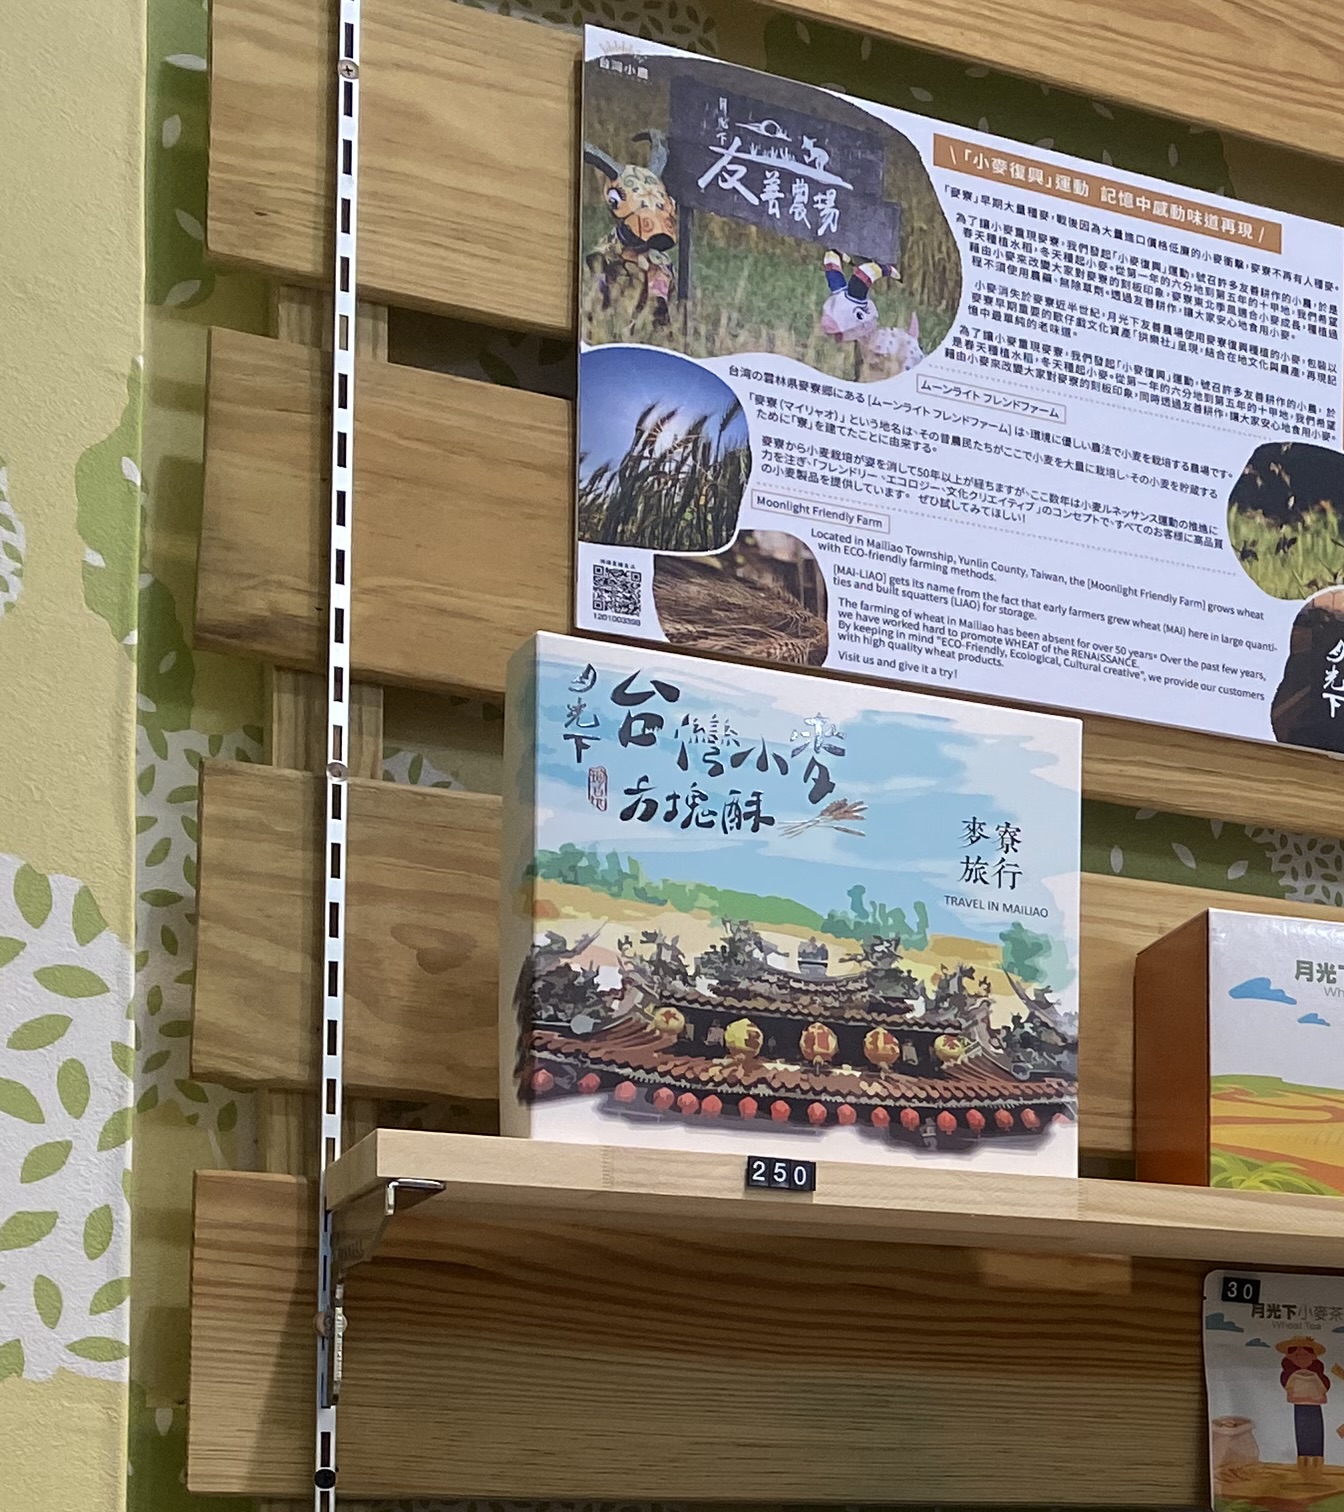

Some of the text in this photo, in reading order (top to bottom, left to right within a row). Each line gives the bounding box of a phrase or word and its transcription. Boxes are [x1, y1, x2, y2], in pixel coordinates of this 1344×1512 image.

[964, 149, 1252, 240] 「小麥復興」運動 記憶中感動味道再現
[920, 379, 1059, 419] ムーンライト フレンドファーム
[756, 495, 882, 528] Moonlight Friendly Farm
[811, 528, 851, 544] Located
[905, 545, 957, 565] Township,
[958, 555, 990, 570] Yunlin
[991, 561, 1028, 579] County,
[817, 540, 841, 554] with
[909, 557, 947, 575] farming
[950, 565, 996, 582] methods.
[838, 650, 867, 664] Visit
[869, 656, 878, 666] us
[898, 661, 919, 674] give
[961, 816, 1023, 853] 麥寮
[959, 854, 1024, 891] 旅行
[944, 895, 1049, 919] TRAVEL IN MAILIAO
[752, 1159, 807, 1186] 250
[1227, 1281, 1252, 1299] 30
[1251, 1304, 1344, 1322] 月光下小麥茶
